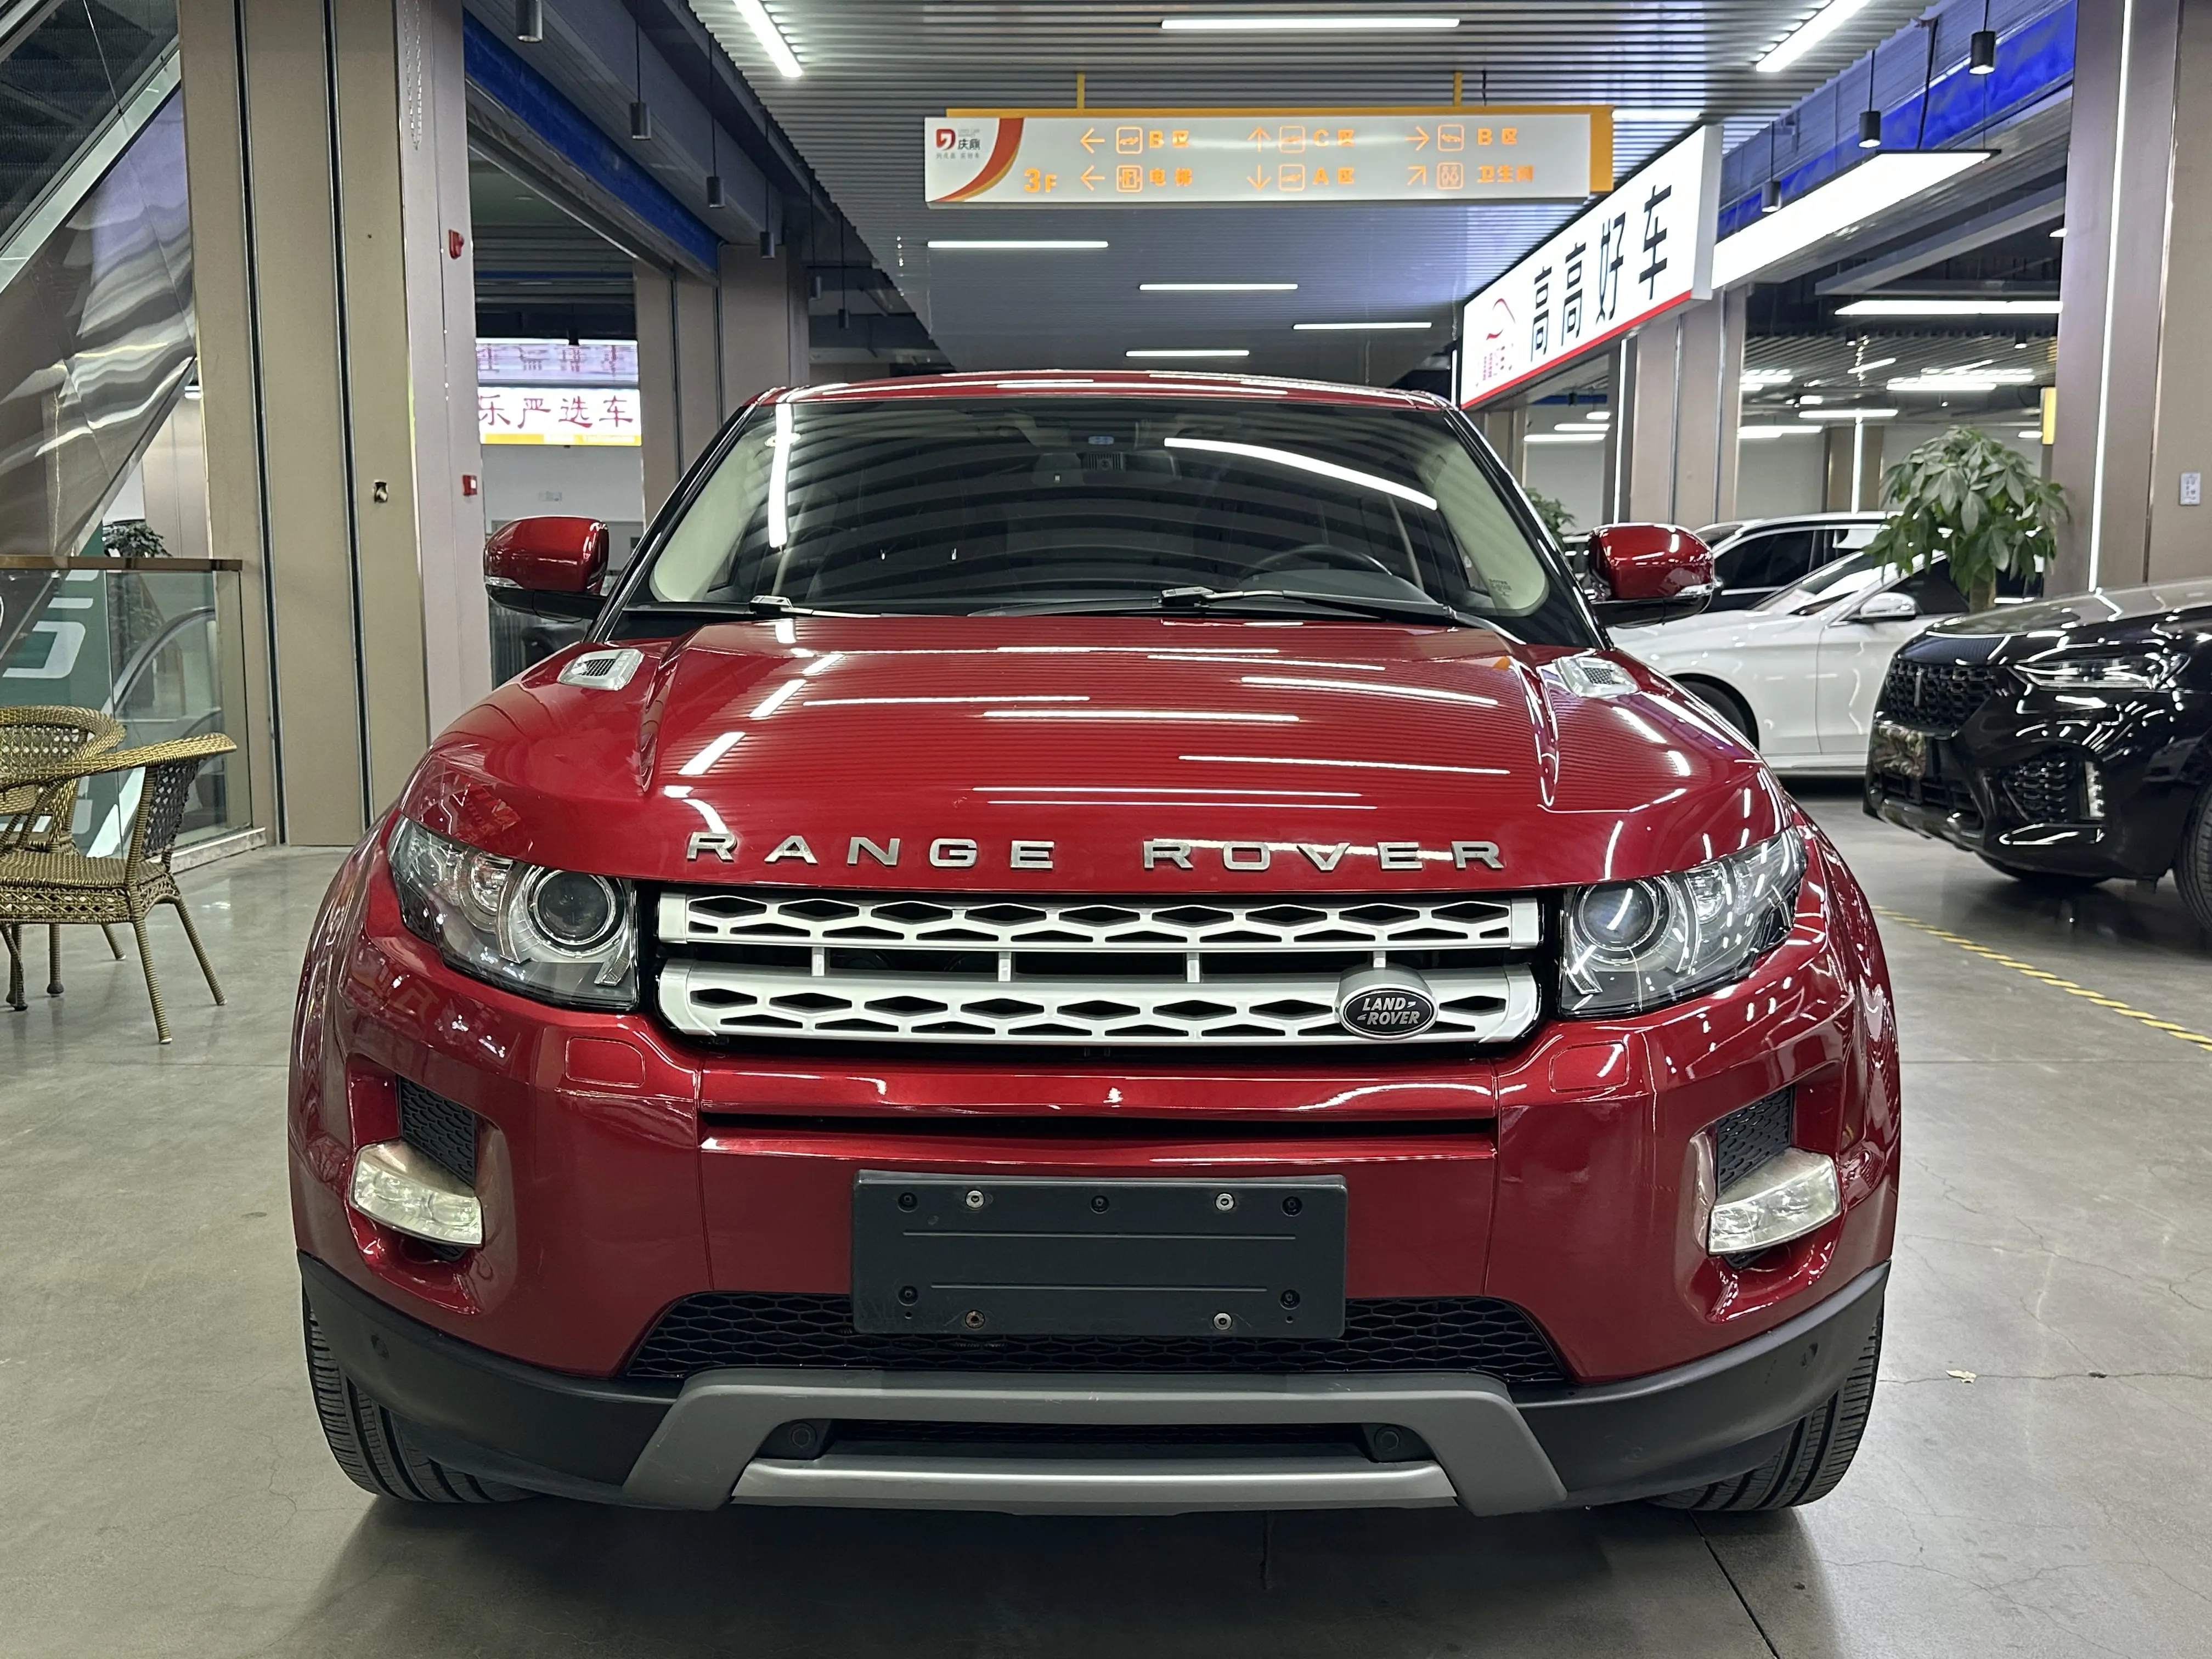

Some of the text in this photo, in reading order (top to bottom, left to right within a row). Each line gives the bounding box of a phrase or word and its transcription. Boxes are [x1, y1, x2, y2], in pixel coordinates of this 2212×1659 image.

[1024, 167, 1058, 193] 3F
[1530, 184, 1672, 363] 高高好车
[686, 831, 1505, 871] RANGE ROVER
[1362, 997, 1406, 1012] LAND
[1367, 1012, 1420, 1025] ROVER
